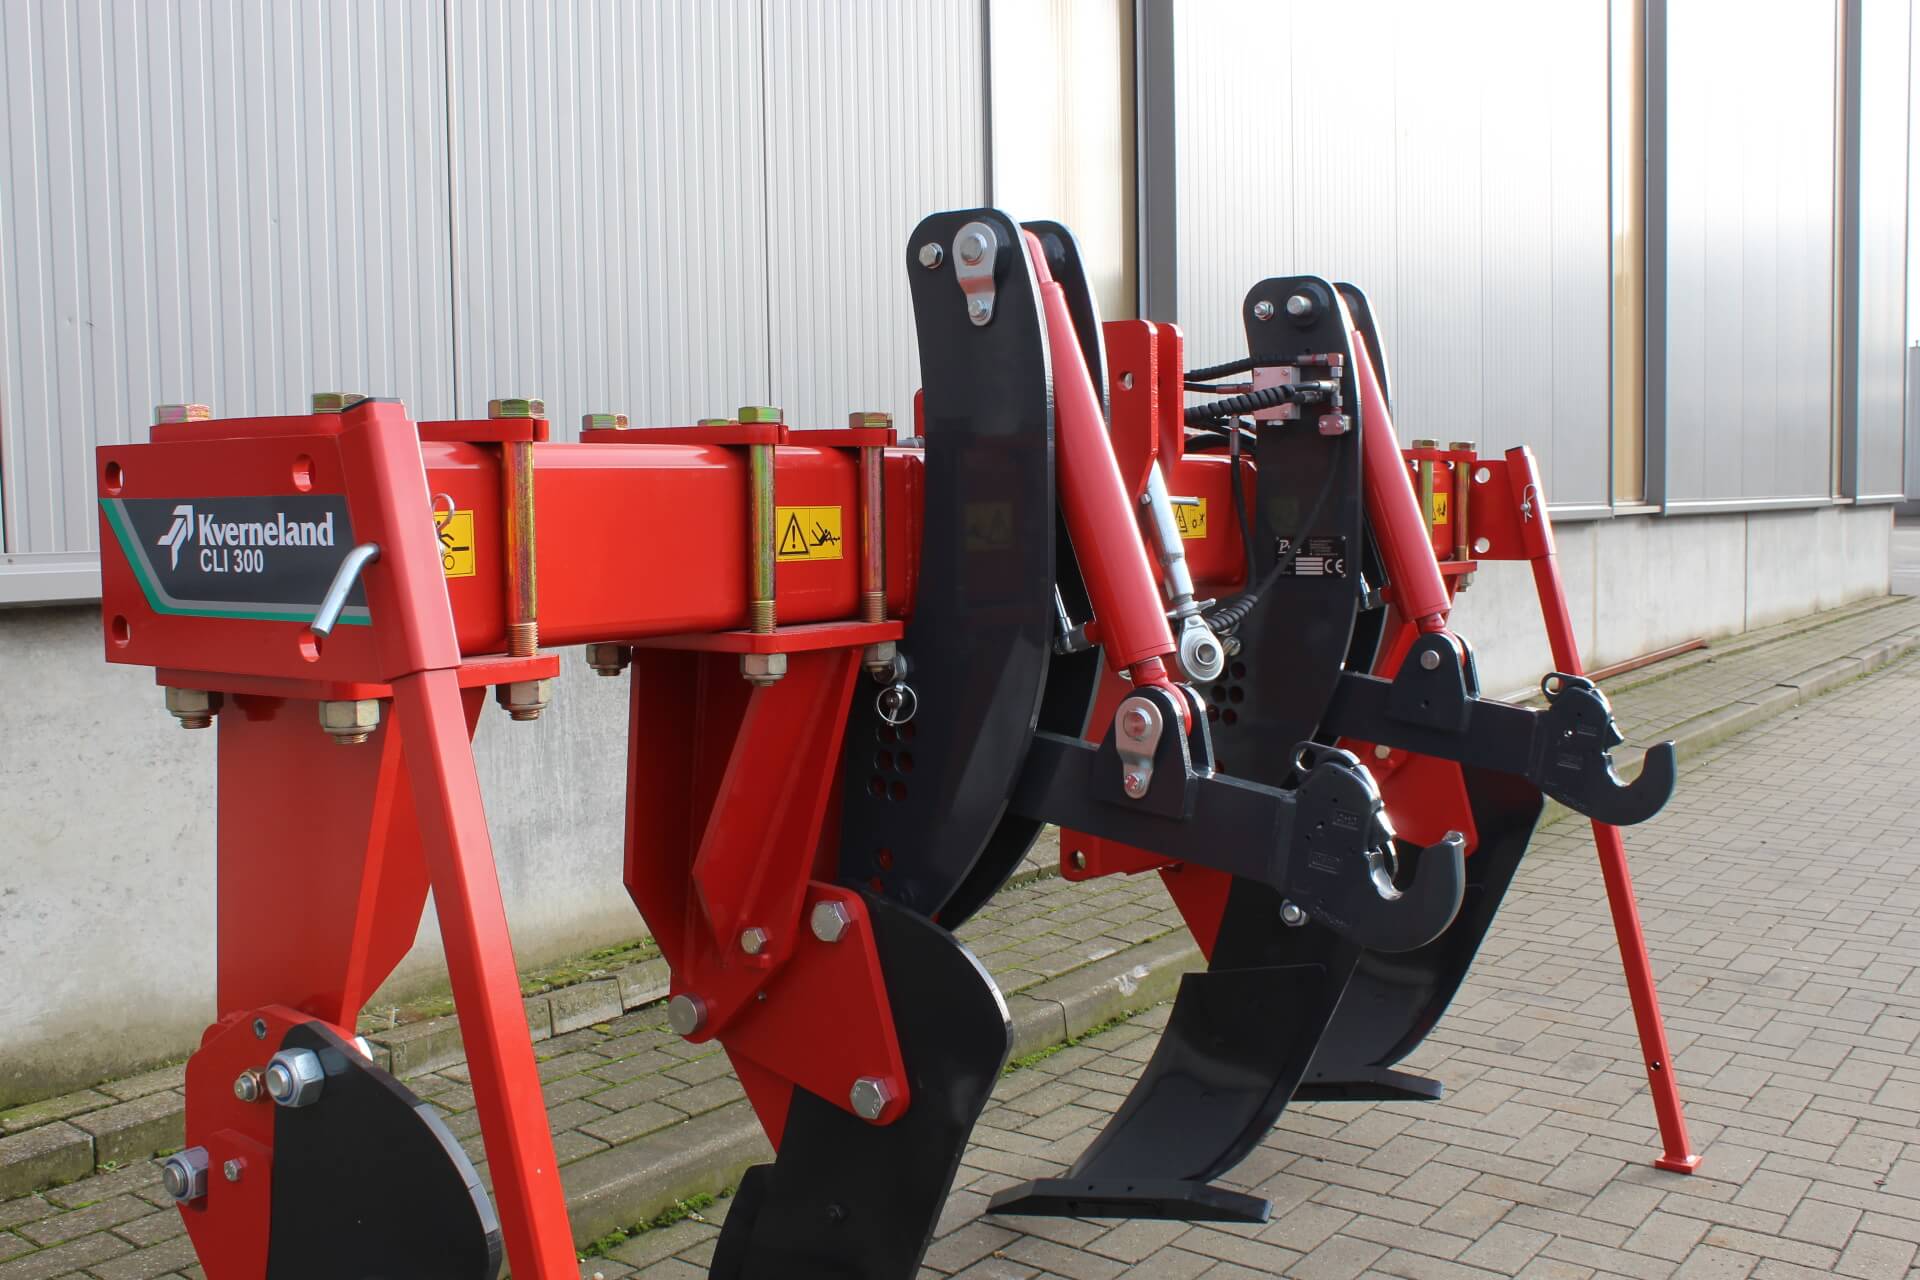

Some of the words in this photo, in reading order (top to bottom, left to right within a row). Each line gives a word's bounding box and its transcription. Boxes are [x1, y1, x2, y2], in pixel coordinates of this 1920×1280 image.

[198, 512, 335, 546] Kverneland
[200, 549, 228, 573] CLI
[233, 548, 264, 573] 300
[1325, 559, 1344, 574] CE
